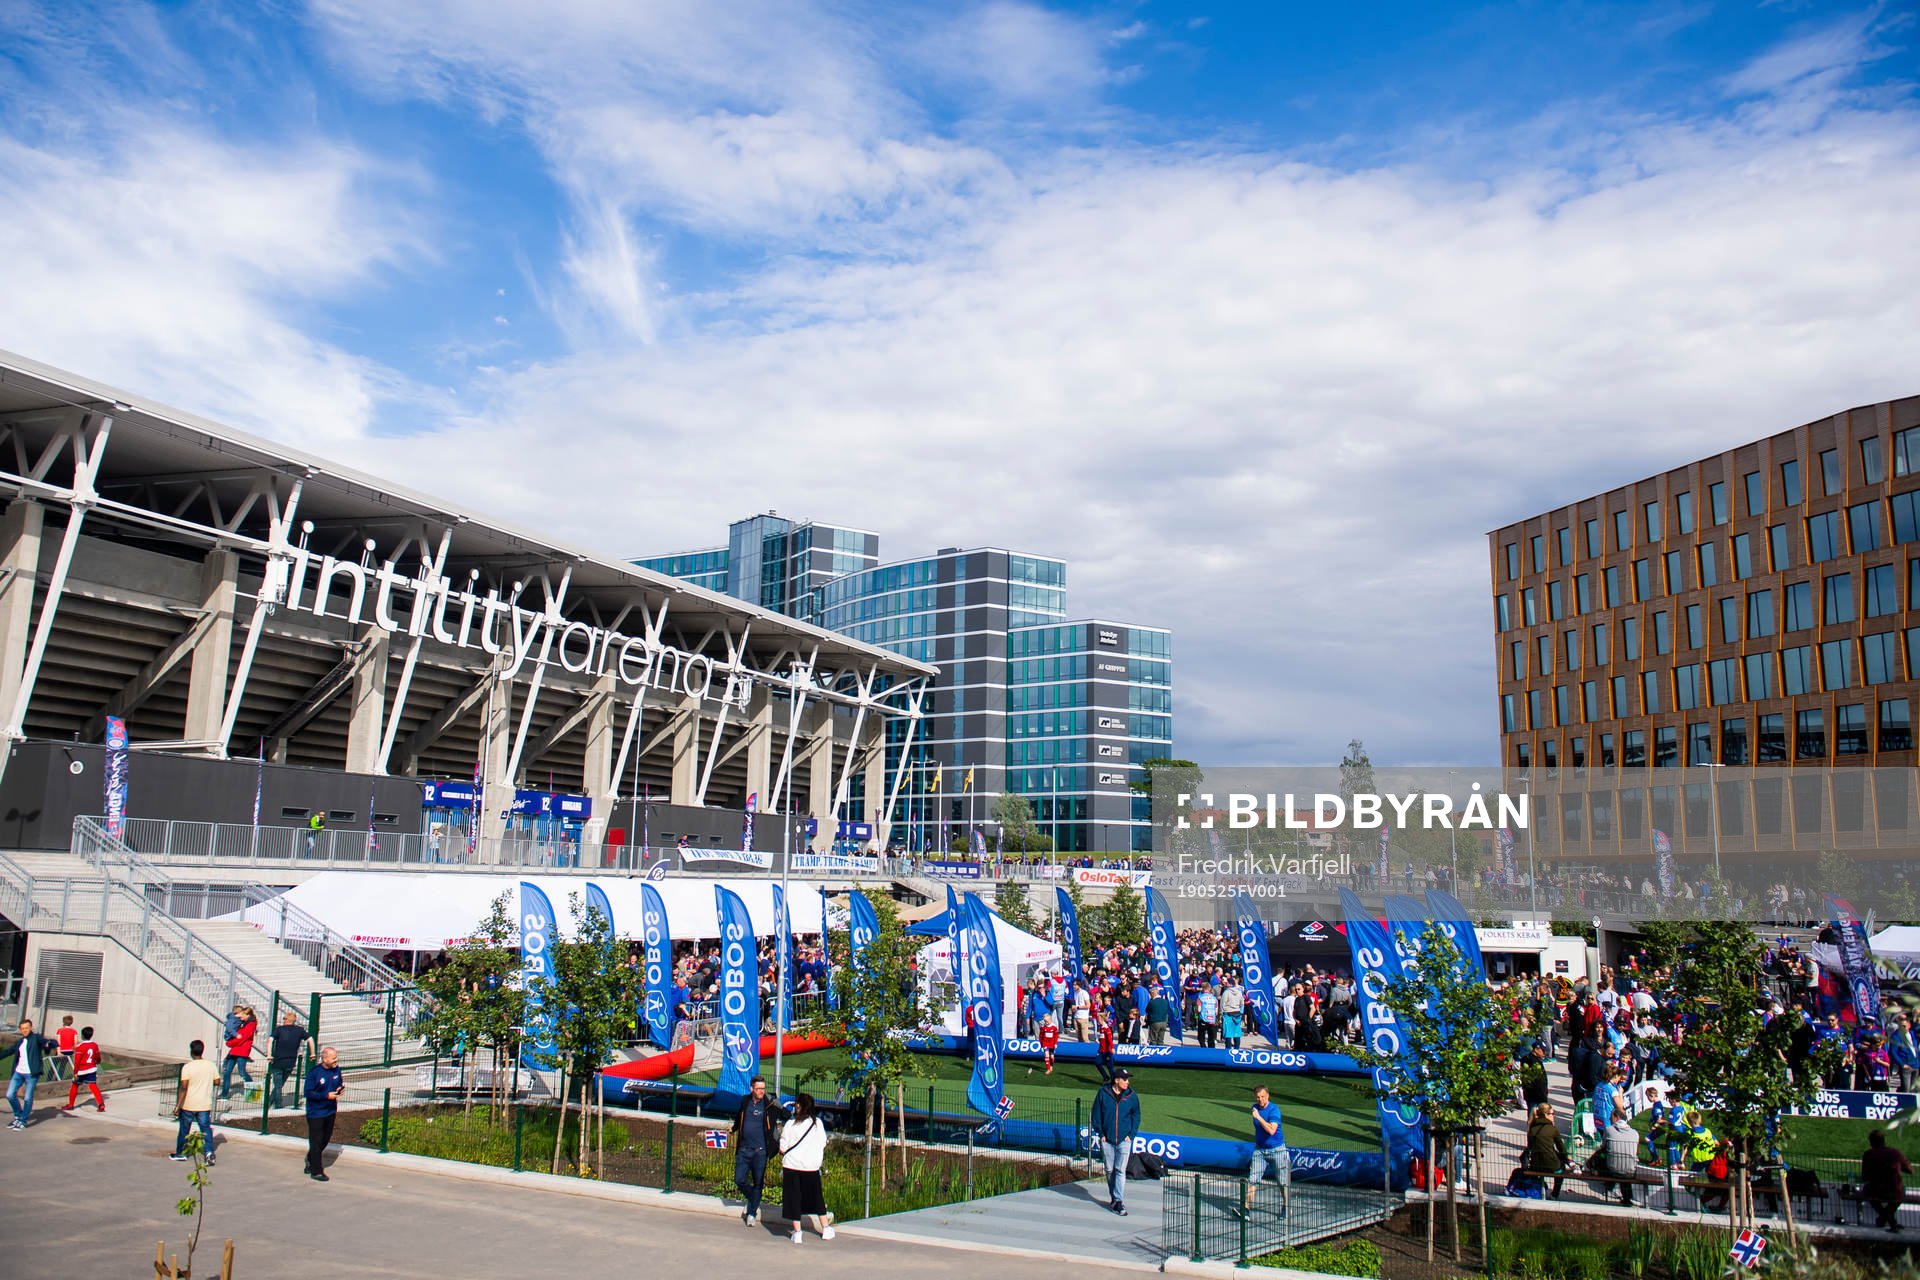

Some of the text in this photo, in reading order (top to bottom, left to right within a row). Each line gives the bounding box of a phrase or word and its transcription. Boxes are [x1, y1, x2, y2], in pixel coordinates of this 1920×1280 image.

[287, 520, 714, 700] intility arena
[424, 785, 435, 801] 12
[542, 797, 551, 811] 12
[1008, 1040, 1042, 1052] OBO
[86, 1048, 93, 1063] 2
[1257, 1052, 1306, 1067] OBOS
[1809, 1104, 1849, 1118] BYGG
[1865, 1106, 1897, 1120] BYG
[1132, 1136, 1180, 1160] BOS
